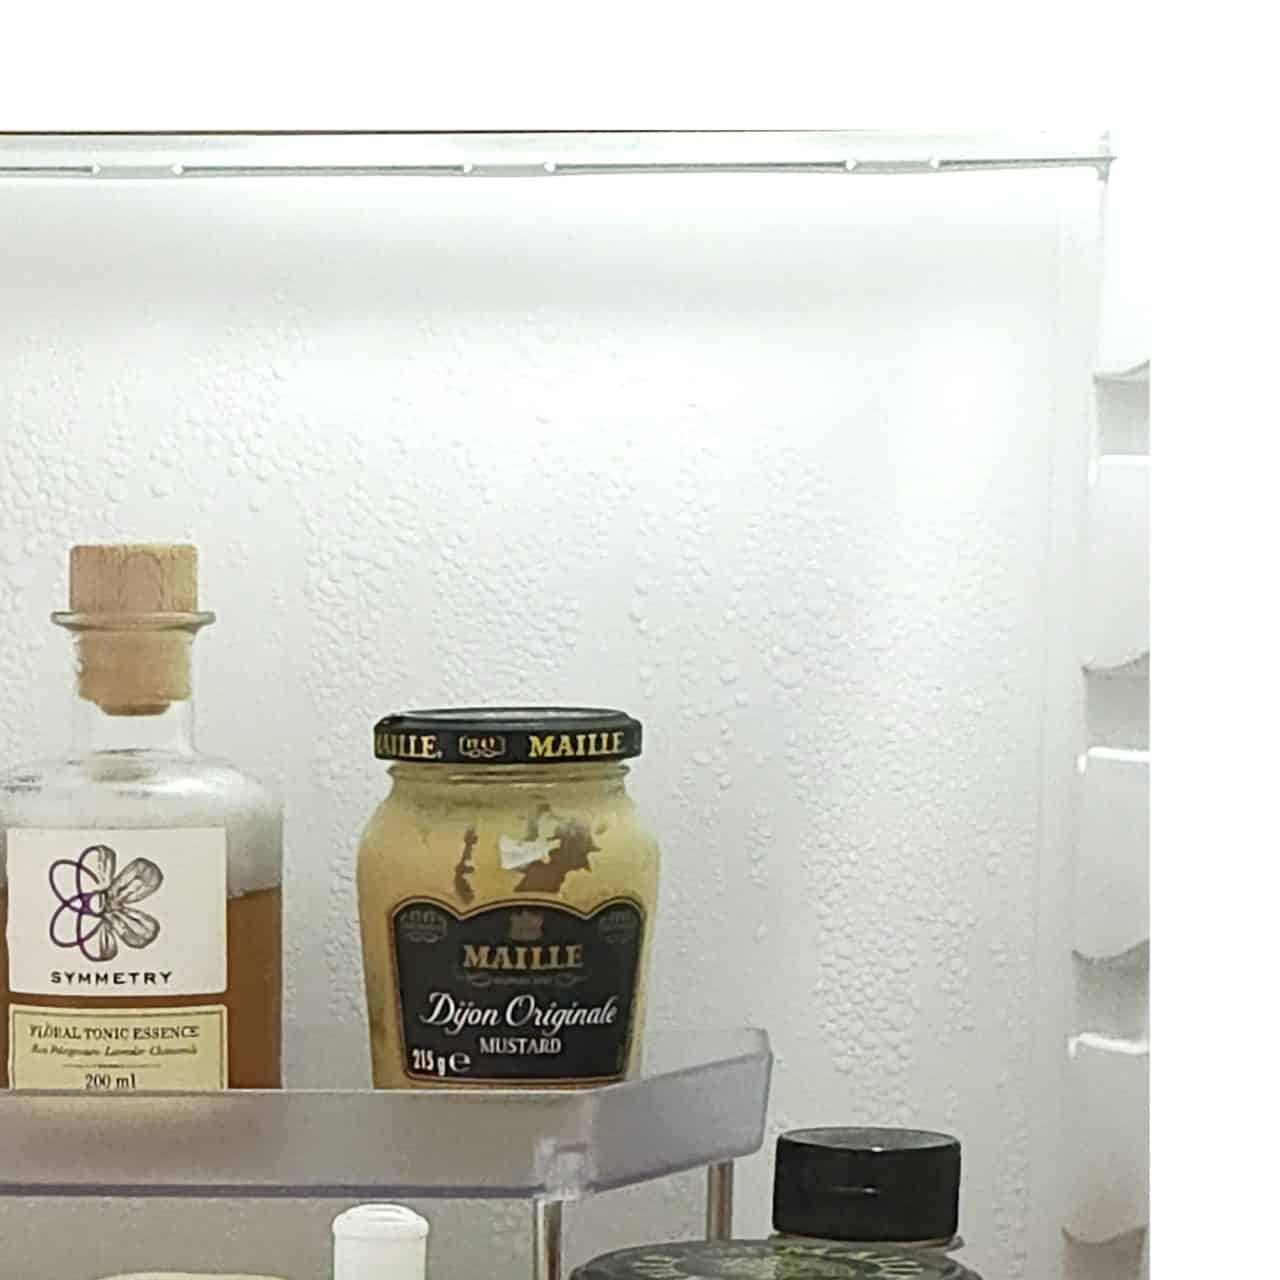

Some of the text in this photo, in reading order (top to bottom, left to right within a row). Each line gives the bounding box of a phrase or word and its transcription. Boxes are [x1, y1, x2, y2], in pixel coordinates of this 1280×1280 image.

[528, 732, 625, 758] MAILLE
[463, 945, 584, 969] MAILLE
[51, 971, 173, 986] SYMMETRY
[420, 992, 618, 1036] Dijon Originale
[84, 1027, 129, 1042] TONIC
[133, 1026, 200, 1041] ESSENCE
[479, 1037, 562, 1055] MUSTARD
[412, 1048, 434, 1071] 215
[85, 1073, 136, 1089] 200 ml
